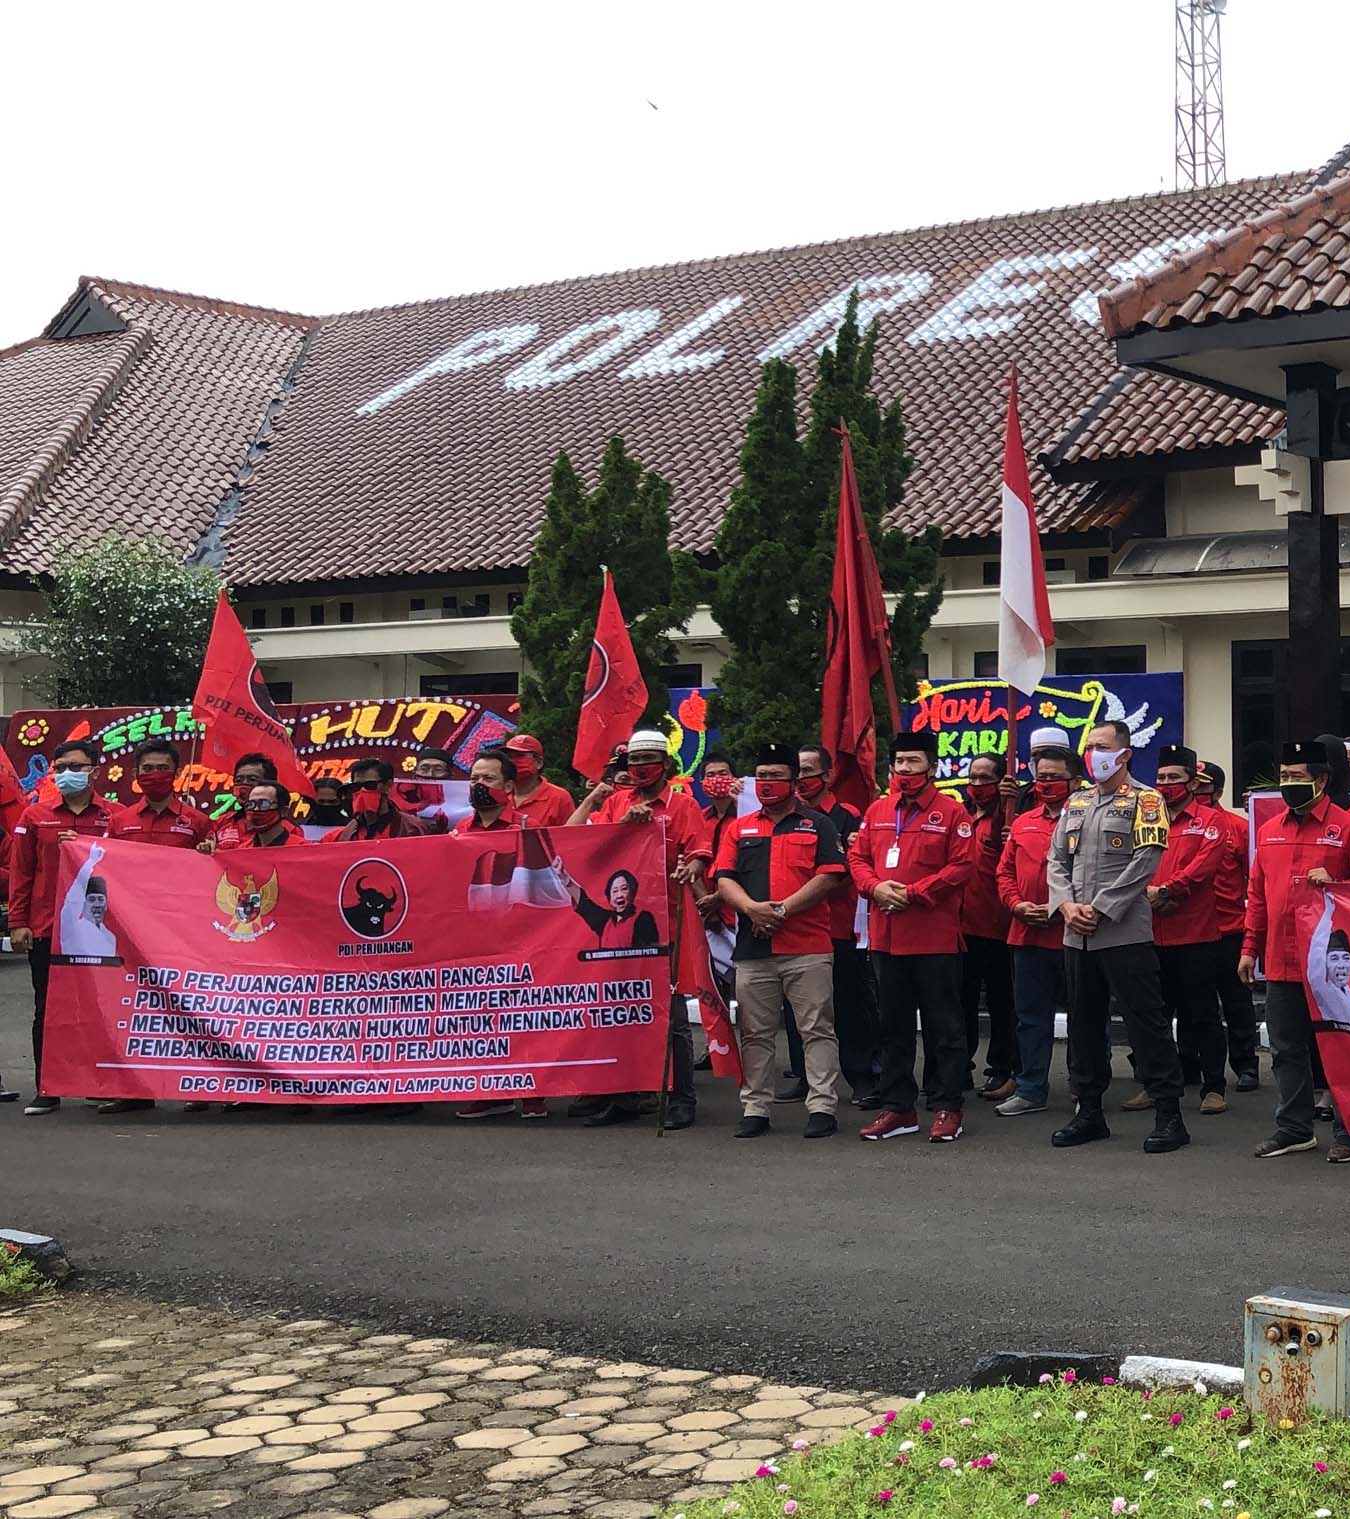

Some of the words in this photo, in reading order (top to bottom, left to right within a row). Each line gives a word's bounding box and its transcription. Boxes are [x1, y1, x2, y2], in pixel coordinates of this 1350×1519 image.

[310, 701, 467, 745] HUT
[1106, 809, 1132, 818] POLRI
[338, 944, 354, 957] PDI
[355, 941, 415, 956] PERJUANGAN
[138, 967, 179, 989] PDIP
[184, 970, 317, 994] PERJUANGAN
[322, 968, 436, 993] BERASASKAN
[441, 963, 532, 988] PANCASILA
[134, 991, 166, 1011] PDI
[170, 993, 303, 1017] PERJUANGAN
[308, 992, 435, 1017] BERKOMITMEN
[440, 984, 598, 1011] MEMPERTAHANKAN
[603, 980, 652, 1001] NKRI
[130, 1014, 238, 1037] MENUNTUT
[241, 1019, 361, 1040] PENEGAKAN
[366, 1016, 430, 1038] HUKUM
[435, 1014, 494, 1036] UNTUK
[498, 1009, 584, 1033] MENINDAK
[588, 1005, 653, 1027] TEGAS
[127, 1038, 258, 1062] PEMBAKARAN
[264, 1043, 356, 1063] BENDERA
[360, 1043, 391, 1063] PDI
[395, 1036, 510, 1061] PERJUANGAN
[179, 1076, 219, 1093] DPC
[223, 1078, 266, 1094] PDIP
[269, 1078, 390, 1095] PERJUANGAN
[394, 1076, 475, 1093] LAMPUNG
[481, 1073, 535, 1091] UTARA
